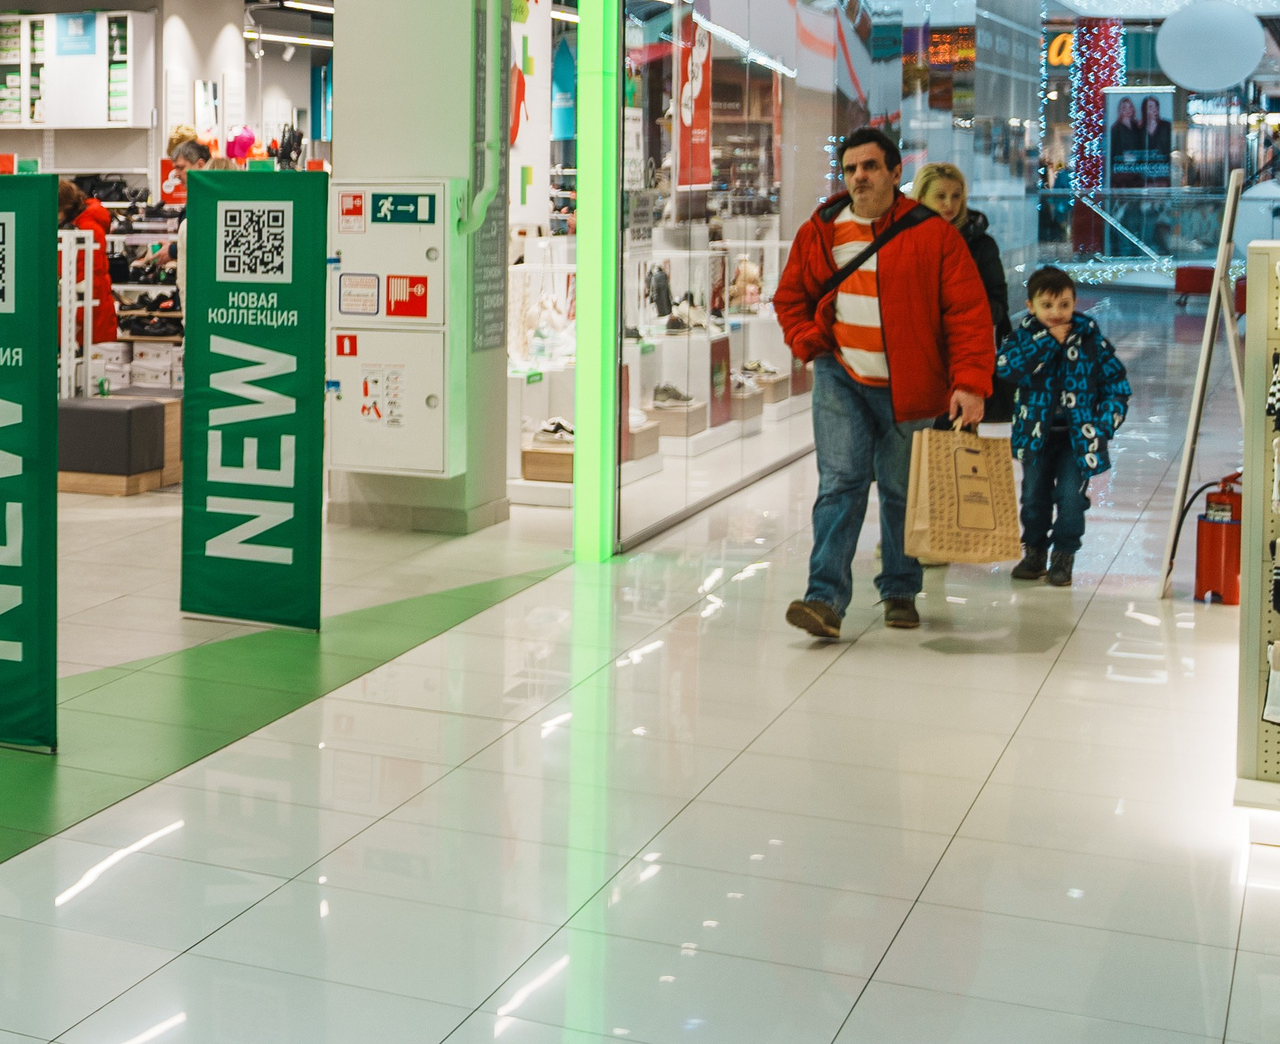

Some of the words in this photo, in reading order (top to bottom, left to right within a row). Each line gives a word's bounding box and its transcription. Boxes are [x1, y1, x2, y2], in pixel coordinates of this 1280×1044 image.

[228, 291, 278, 309] НОВАЯ
[208, 308, 298, 329] КОЛЛЕКЦИЯ
[204, 333, 297, 566] NEW
